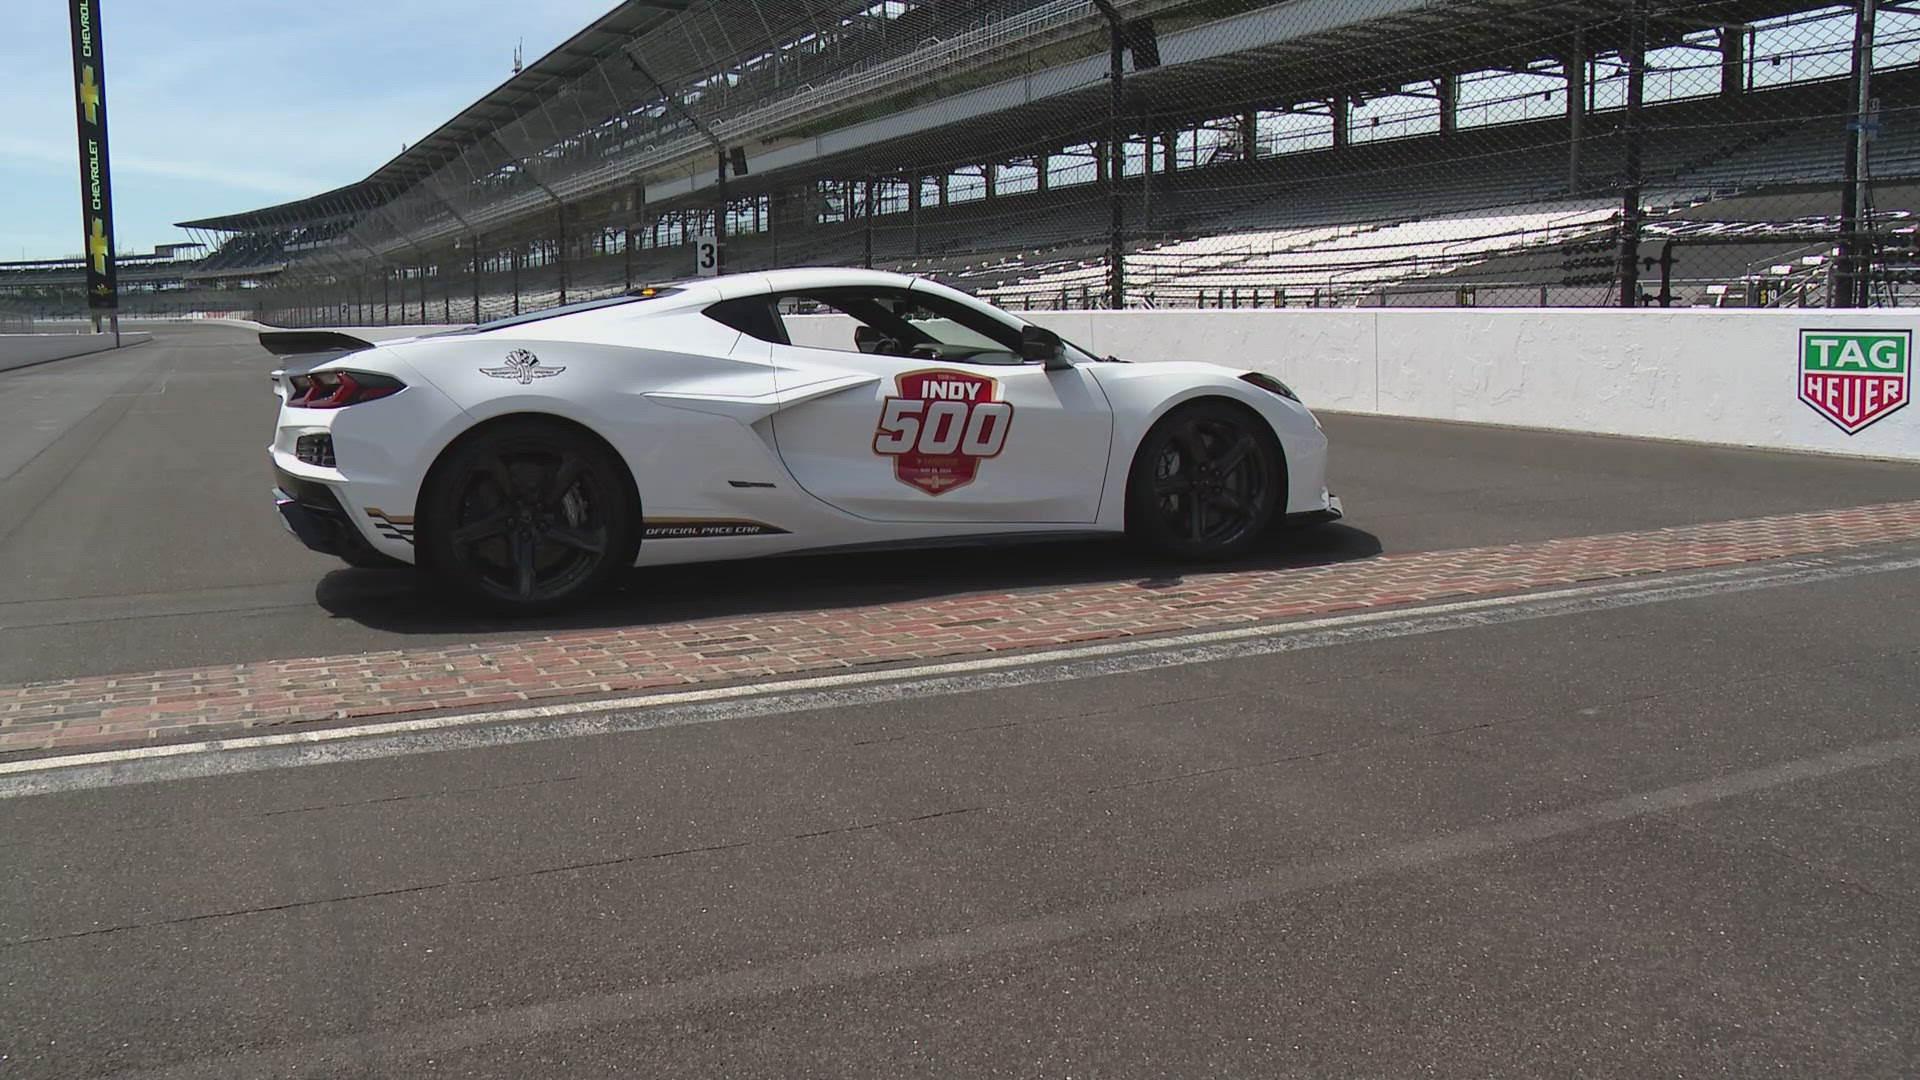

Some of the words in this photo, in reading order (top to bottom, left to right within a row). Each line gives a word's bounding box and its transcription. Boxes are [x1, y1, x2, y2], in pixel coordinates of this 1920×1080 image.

[88, 139, 100, 210] CHEVROLET
[701, 243, 715, 269] 3
[342, 304, 347, 313] 2
[1810, 339, 1898, 369] TAG
[921, 380, 982, 400] INDY
[1807, 377, 1900, 423] HEUER
[874, 398, 1013, 456] 500
[701, 527, 733, 535] PACE
[735, 526, 760, 534] CAR
